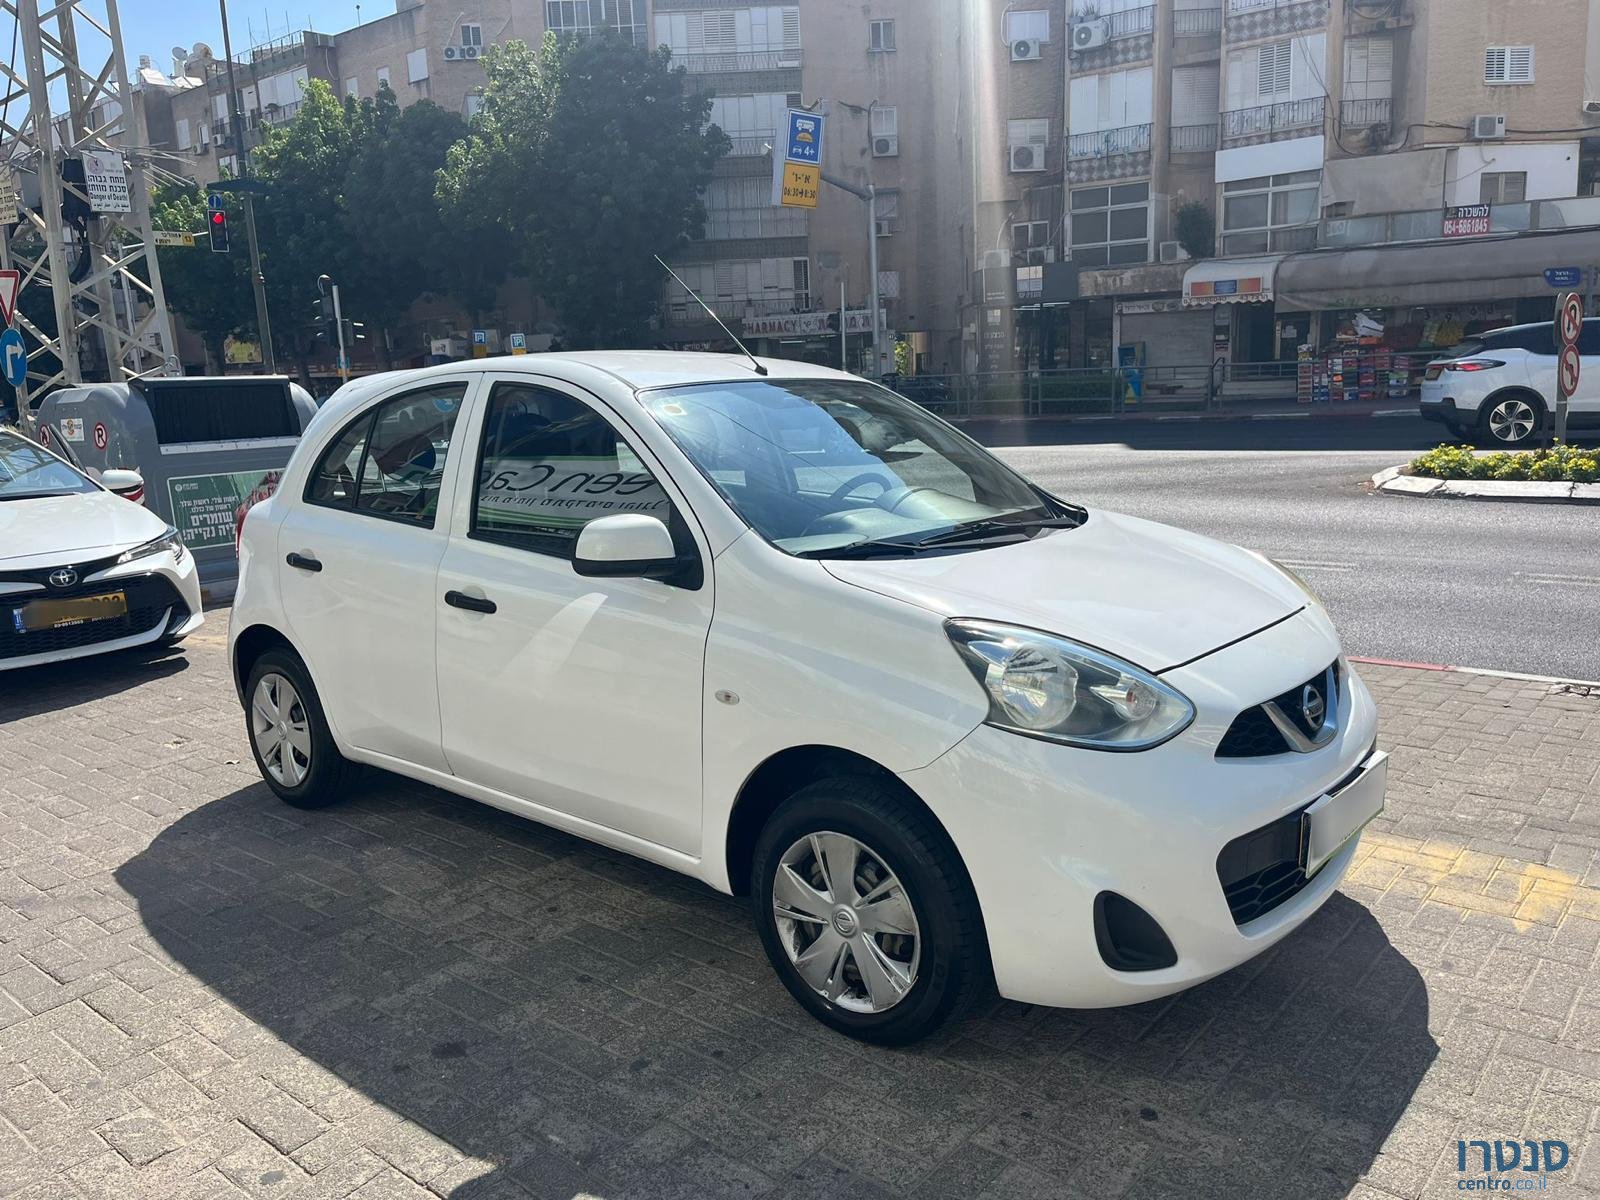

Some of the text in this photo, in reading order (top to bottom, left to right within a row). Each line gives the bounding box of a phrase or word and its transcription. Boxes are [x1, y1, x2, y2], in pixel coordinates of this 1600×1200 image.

[109, 176, 125, 184] מתח
[109, 185, 127, 193] סכנת
[1458, 204, 1489, 218] להשכרה
[191, 511, 233, 526] שומרים
[183, 522, 237, 541] ליה נקייה!
